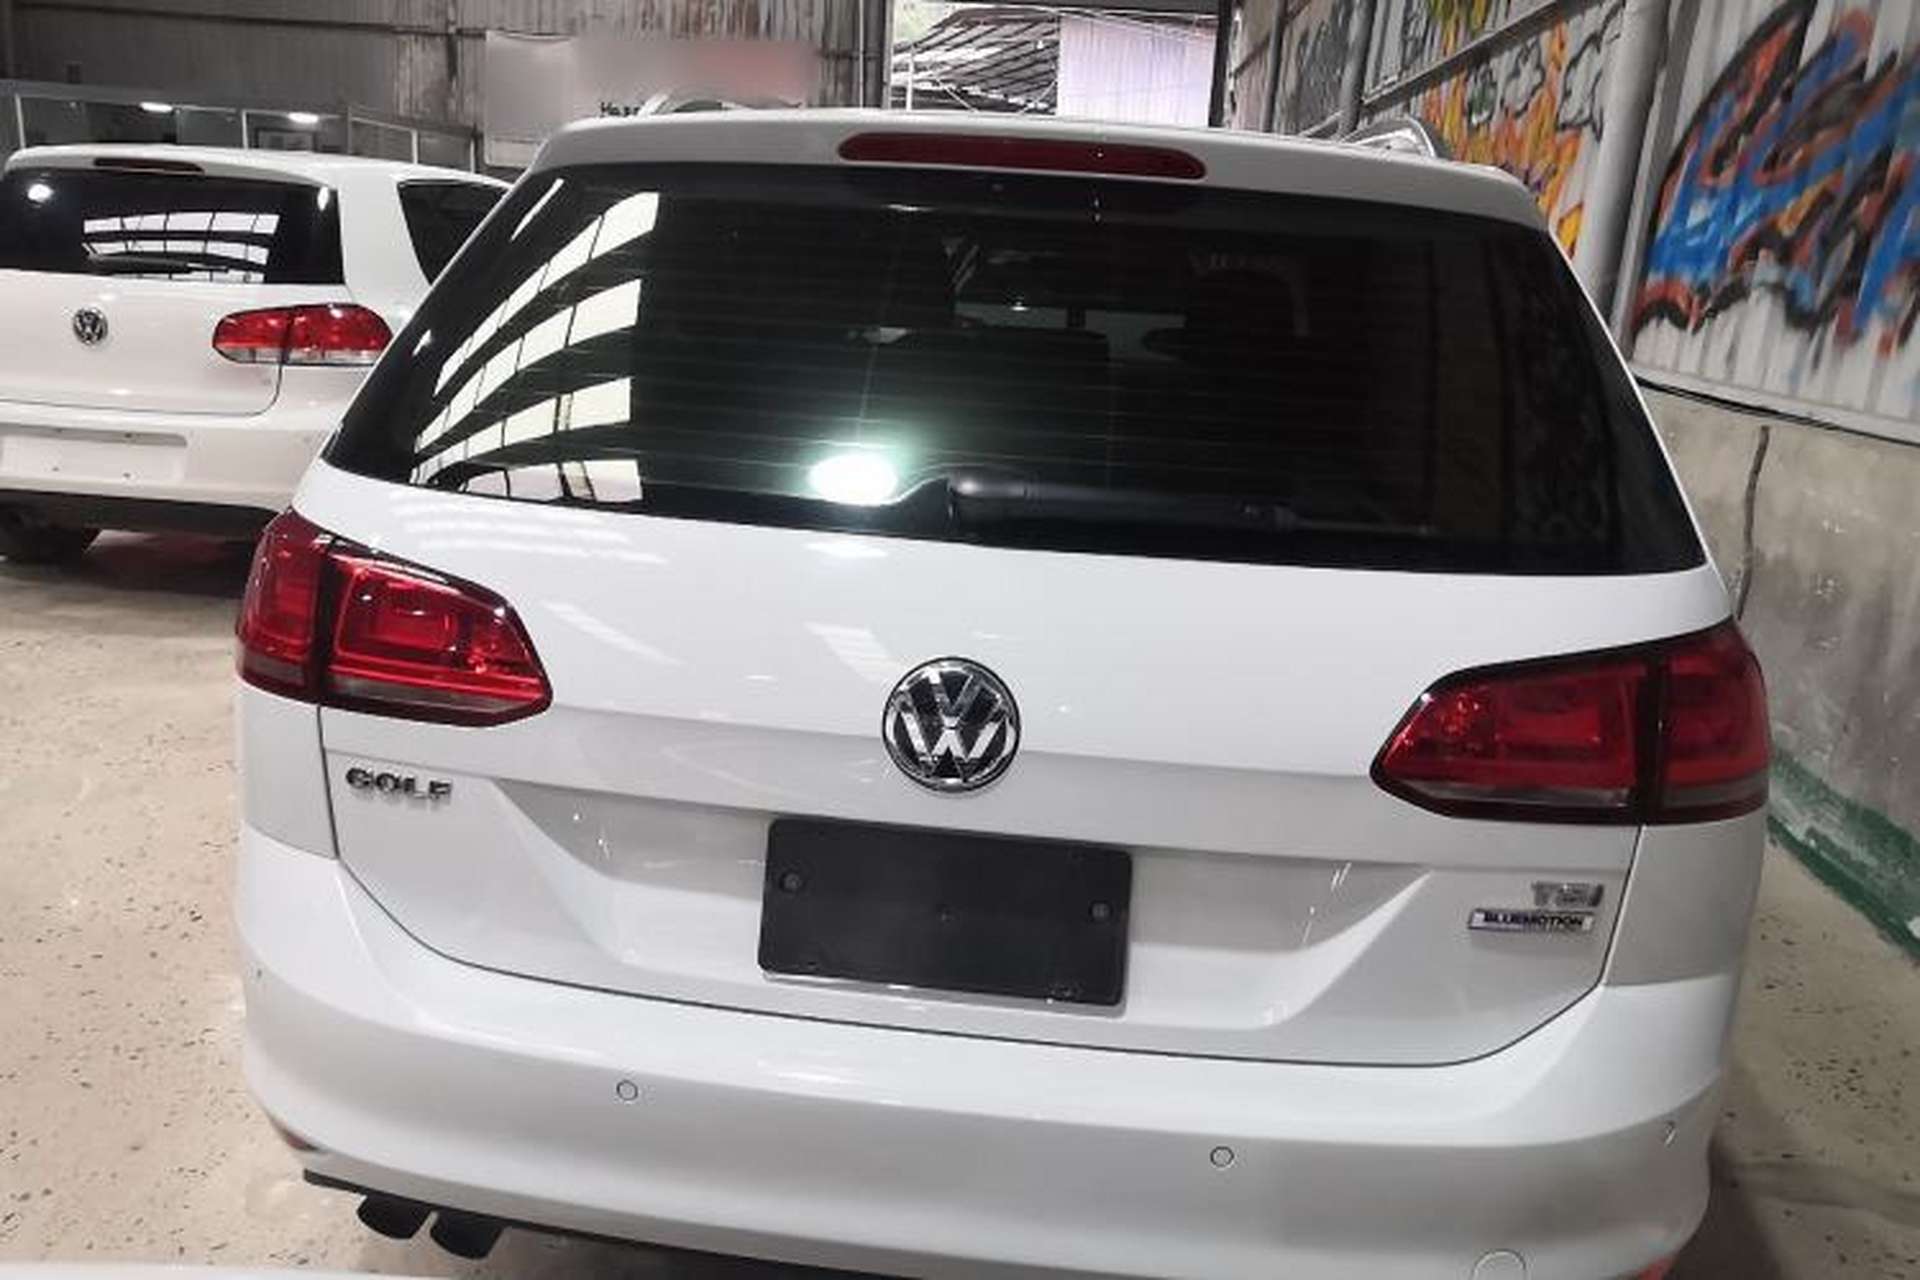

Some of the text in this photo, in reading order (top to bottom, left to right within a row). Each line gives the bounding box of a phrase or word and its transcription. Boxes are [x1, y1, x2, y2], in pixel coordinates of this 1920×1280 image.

[885, 659, 1018, 790] VW
[345, 767, 453, 803] GOLF
[1483, 911, 1584, 927] BLUEMOTION
